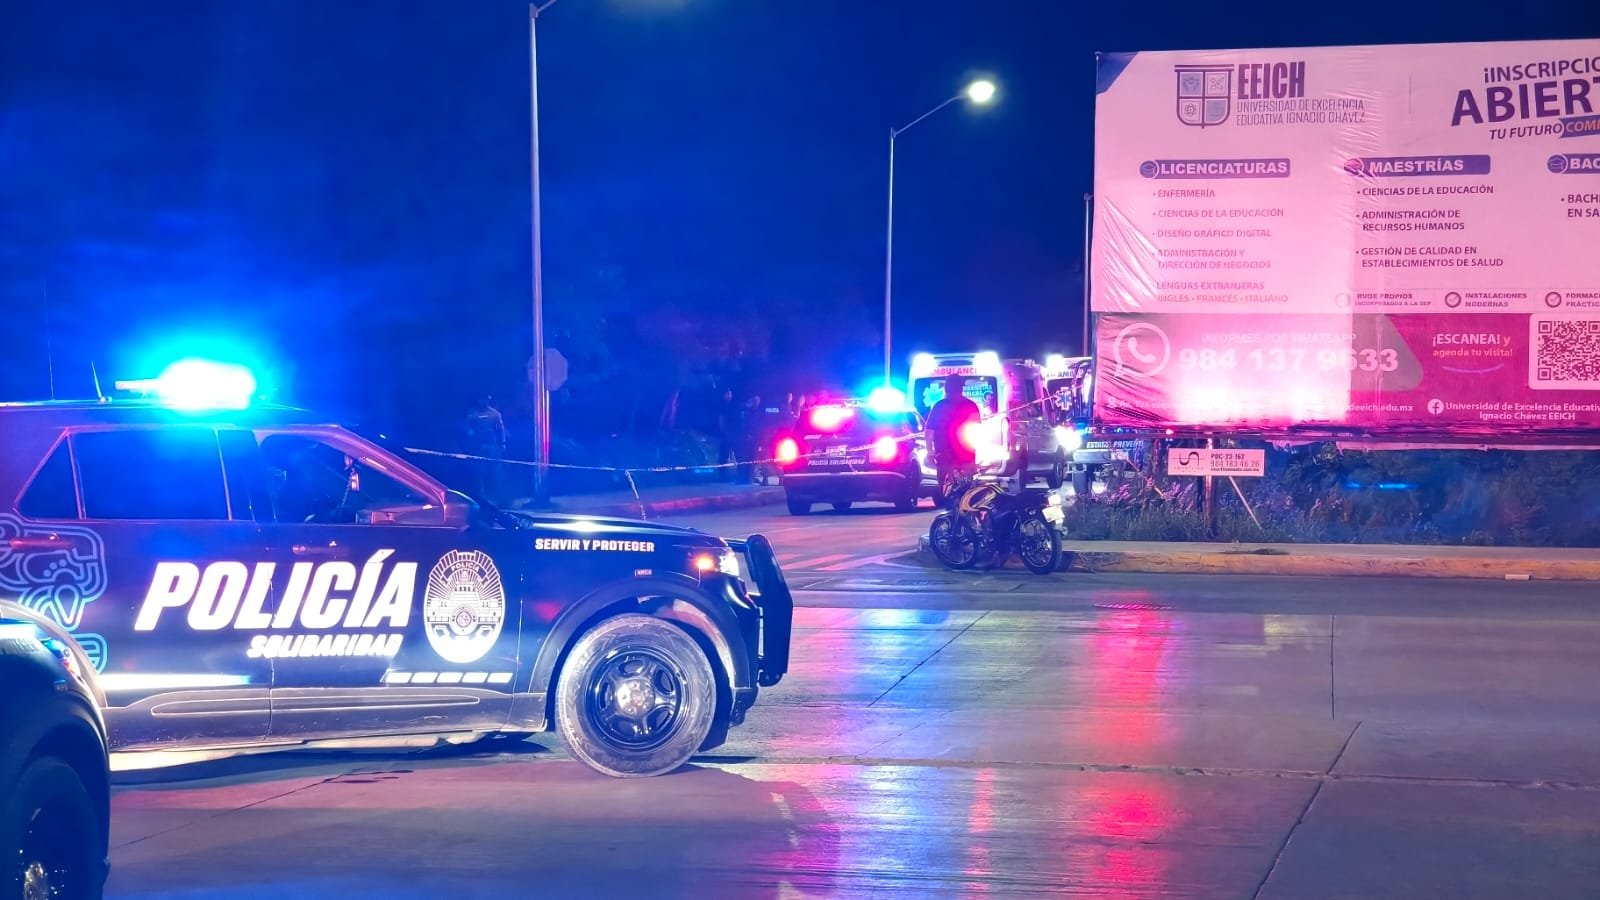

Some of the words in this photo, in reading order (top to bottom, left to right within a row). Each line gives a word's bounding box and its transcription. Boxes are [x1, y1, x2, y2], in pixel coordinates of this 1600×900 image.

[1237, 61, 1306, 99] EEICH
[1237, 100, 1296, 113] UNIVERSIDAD
[1300, 100, 1310, 111] DE
[1311, 99, 1364, 111] EXCELENCIA
[1451, 76, 1600, 126] ABIER
[1237, 113, 1283, 126] EDUCATIVA
[1286, 112, 1325, 124] IGNACIO
[1489, 128, 1506, 140] TU
[1509, 123, 1562, 139] FUTURO
[1160, 161, 1287, 175] LICENCIATURAS
[1370, 158, 1464, 173] MAESTRÍAS
[1158, 188, 1215, 198] ENFERMERÍA
[1362, 187, 1405, 196] CIENCIAS
[1407, 187, 1420, 195] DE
[1422, 187, 1434, 195] LA
[1436, 185, 1494, 195] EDUCACIÓN
[1158, 209, 1199, 218] CIENCIAS
[1201, 209, 1213, 218] DE
[1216, 209, 1227, 217] LA
[1229, 207, 1284, 217] EDUCACIÓN
[1362, 209, 1445, 219] ADMINISTRACIÓN
[1447, 210, 1460, 218] DE
[1567, 208, 1583, 218] EN
[1362, 223, 1412, 232] RECURSOS
[1414, 222, 1465, 231] HUMANOS
[1157, 228, 1191, 238] DISEÑO
[1236, 229, 1272, 237] DIGITAL
[1239, 249, 1245, 257] Y
[1361, 246, 1402, 256] GESTIÓN
[1404, 247, 1417, 255] DE
[1418, 247, 1462, 255] CALIDAD
[1464, 246, 1477, 254] EN
[1362, 259, 1454, 268] ESTABLECIMIENTOS
[1456, 259, 1469, 267] DE
[1471, 258, 1504, 267] SALUD
[1156, 281, 1199, 290] LENGUAS
[1432, 333, 1500, 347] ¡ESCANEA!
[1503, 336, 1511, 346] y
[1432, 349, 1470, 358] agenda
[1471, 349, 1482, 357] tu
[1178, 348, 1238, 372] 984
[1248, 348, 1306, 372] 137
[1318, 348, 1399, 372] 9633
[1446, 402, 1500, 411] Universidad
[1502, 402, 1513, 411] de
[1515, 403, 1561, 411] Excelencia
[1480, 411, 1512, 420] Ignacio
[1548, 412, 1575, 420] EEICH
[535, 538, 580, 551] SERVIR
[582, 540, 593, 551] Y
[592, 540, 655, 552] PROTEGER
[134, 549, 418, 631] POLICÍA
[246, 634, 403, 659] SOLIDARIDAD
